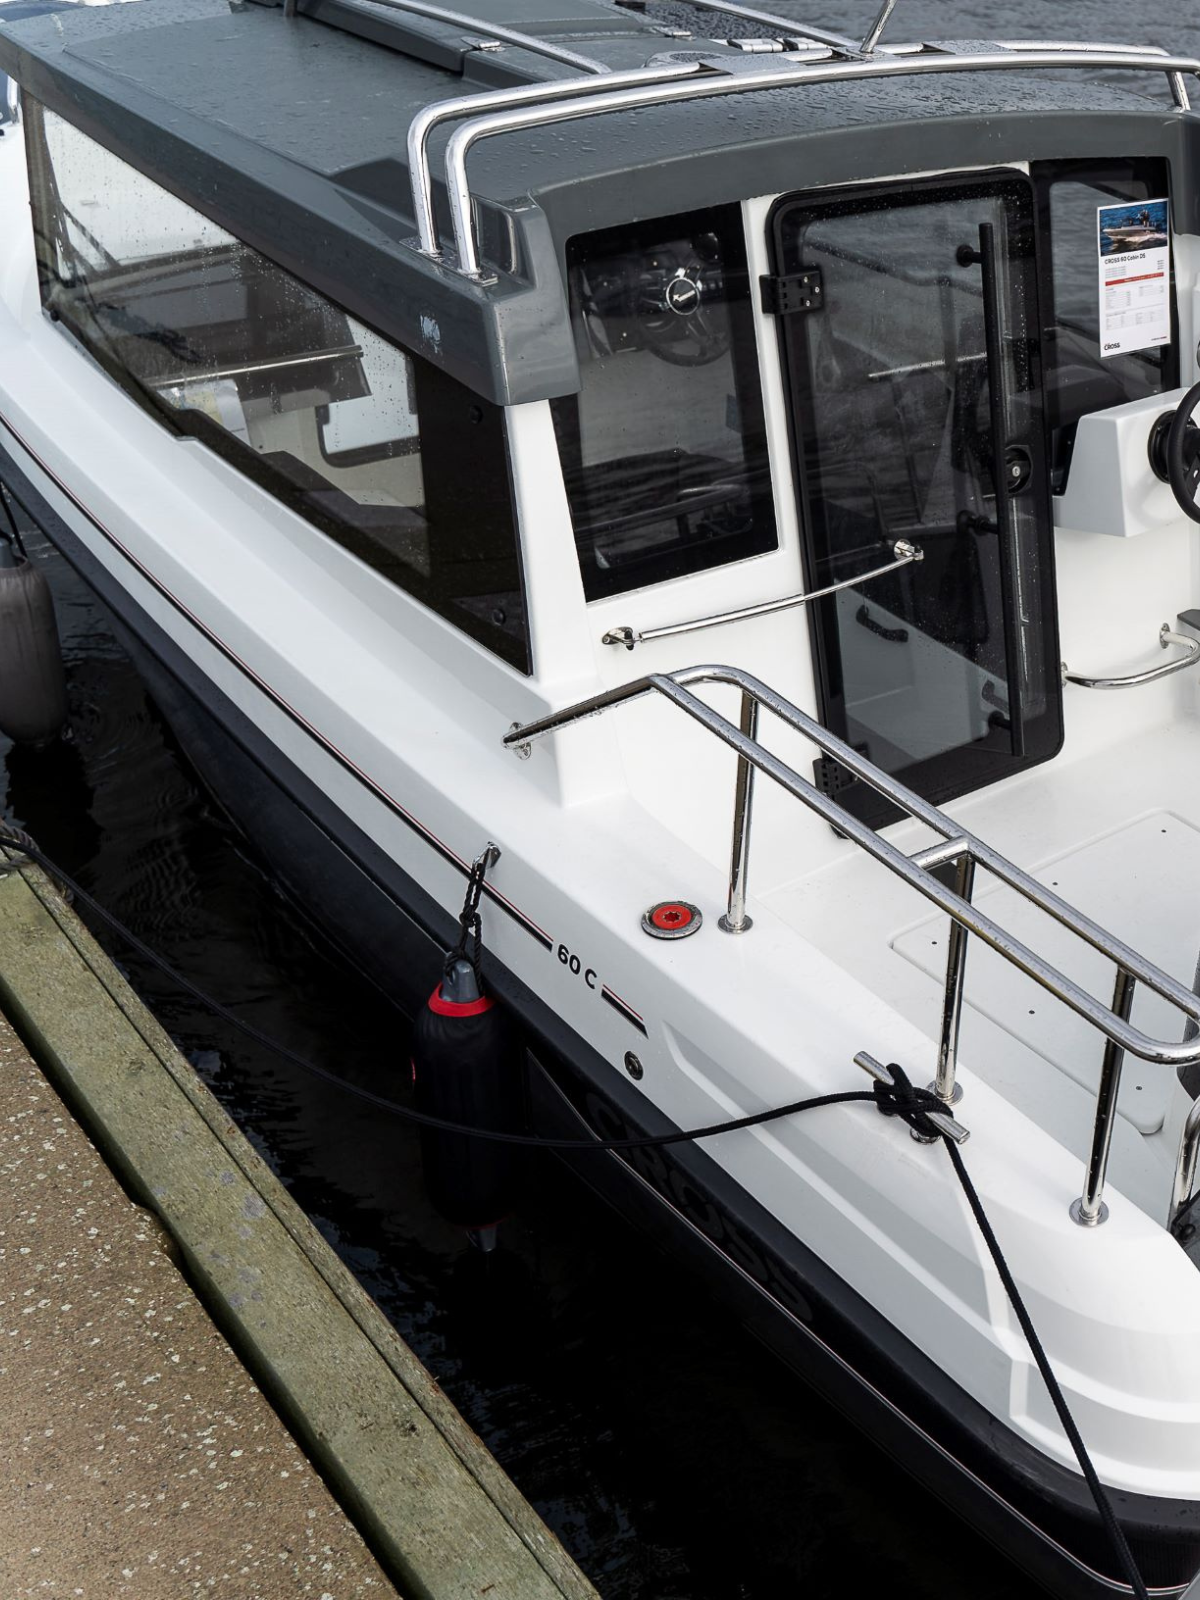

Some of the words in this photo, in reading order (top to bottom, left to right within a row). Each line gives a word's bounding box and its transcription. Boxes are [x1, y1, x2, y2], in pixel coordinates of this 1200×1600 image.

[1104, 257, 1120, 265] CROSS
[1103, 342, 1121, 351] CROSS
[557, 943, 581, 976] 60
[584, 968, 598, 990] C
